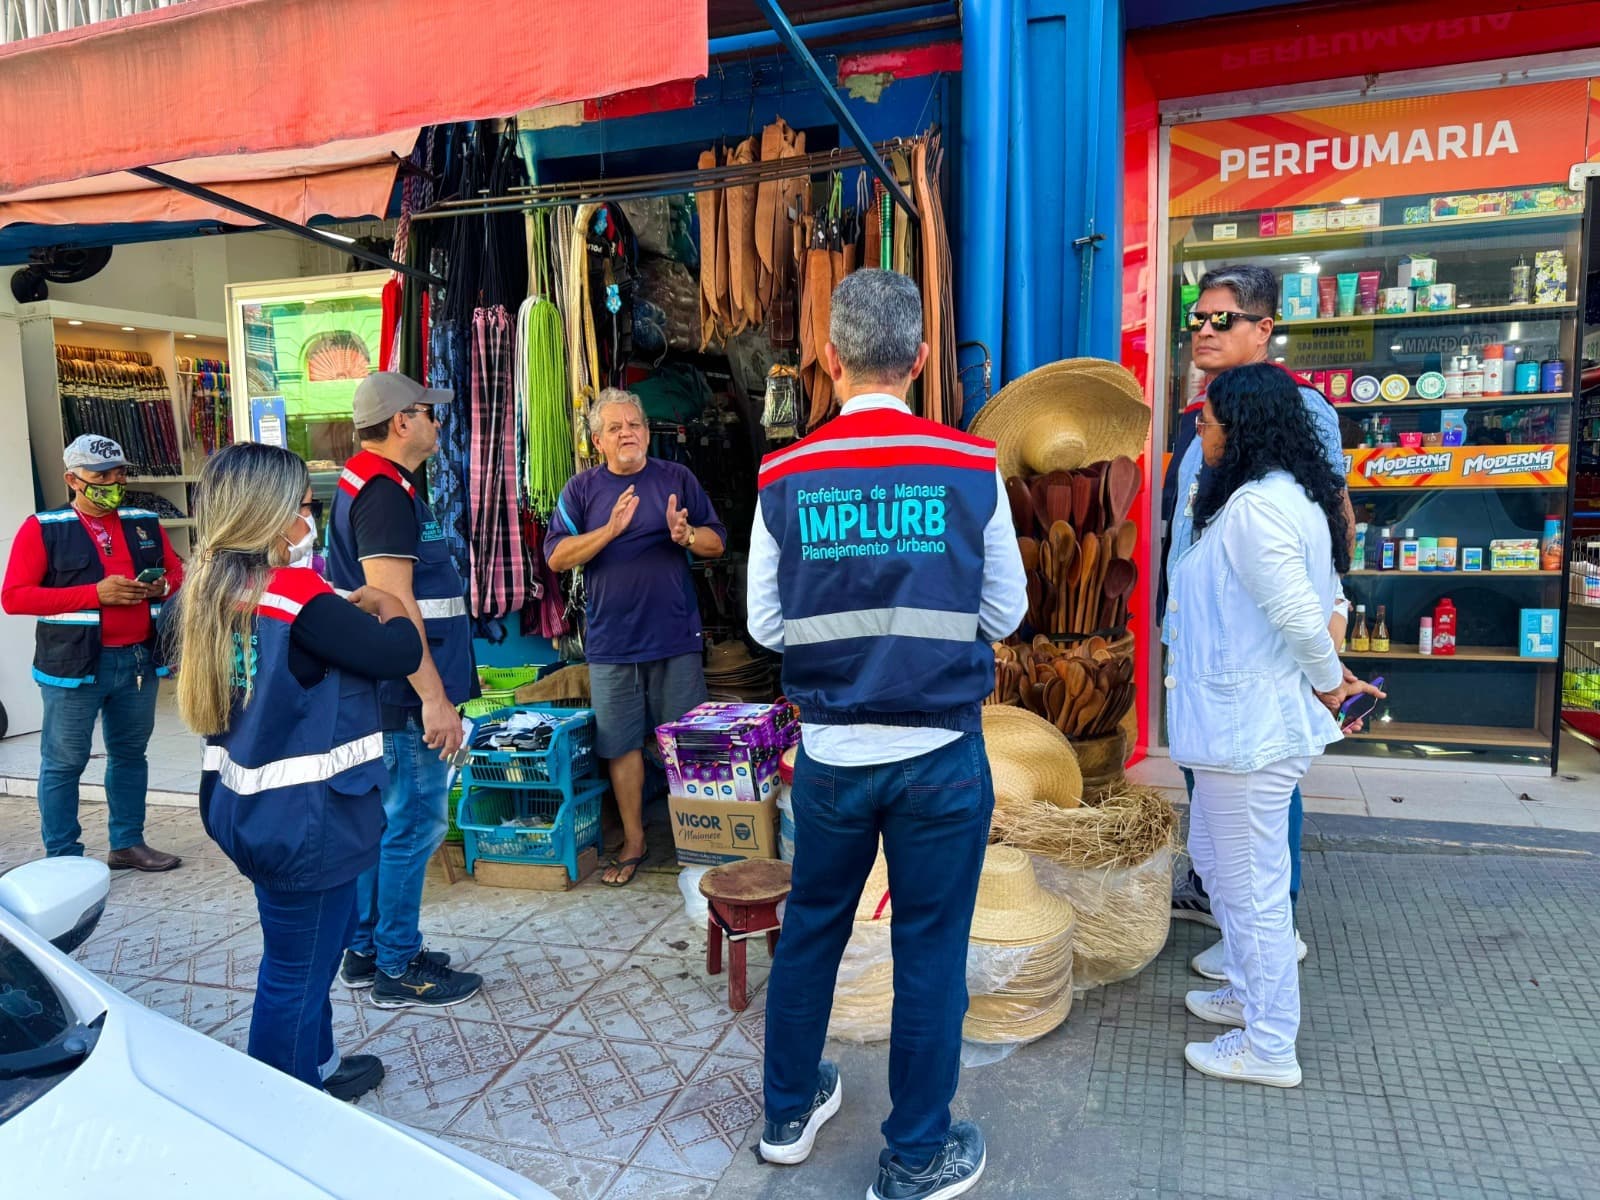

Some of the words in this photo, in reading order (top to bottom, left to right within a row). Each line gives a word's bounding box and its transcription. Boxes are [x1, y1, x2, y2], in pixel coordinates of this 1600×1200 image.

[1219, 119, 1519, 182] PERFUMARIA
[1364, 451, 1452, 478] MODERNA
[1463, 450, 1554, 476] MODERNA
[797, 487, 862, 504] Prefeitura
[870, 484, 887, 500] de
[895, 483, 946, 499] Manaus
[798, 499, 946, 543] IMPLURB
[802, 542, 889, 562] Planejamento
[896, 537, 946, 553] Urbano
[675, 810, 722, 831] VIGOR
